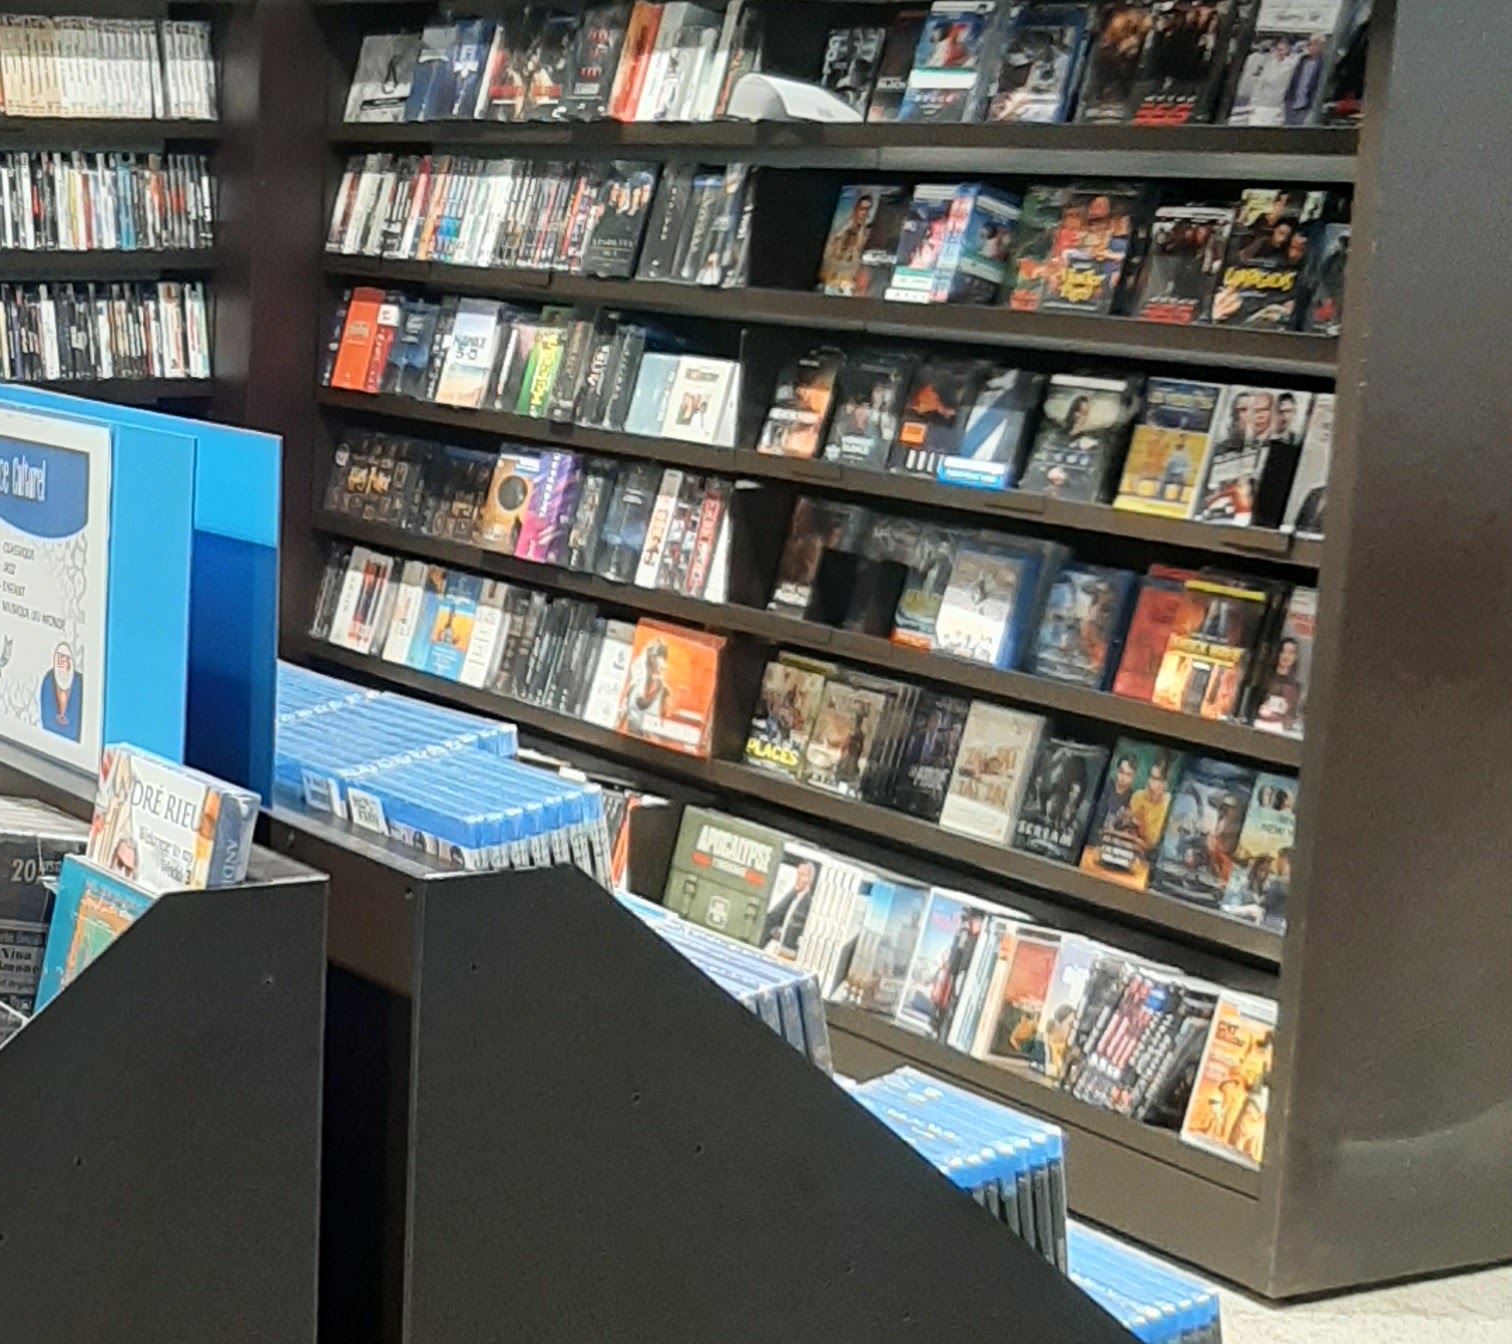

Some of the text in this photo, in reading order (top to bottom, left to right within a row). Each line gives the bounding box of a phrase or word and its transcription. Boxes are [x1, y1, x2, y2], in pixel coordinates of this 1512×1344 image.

[12, 454, 47, 503] Culturel
[745, 737, 801, 766] PLACES
[163, 793, 204, 832] RIEU
[695, 824, 774, 874] APOCALYPSE
